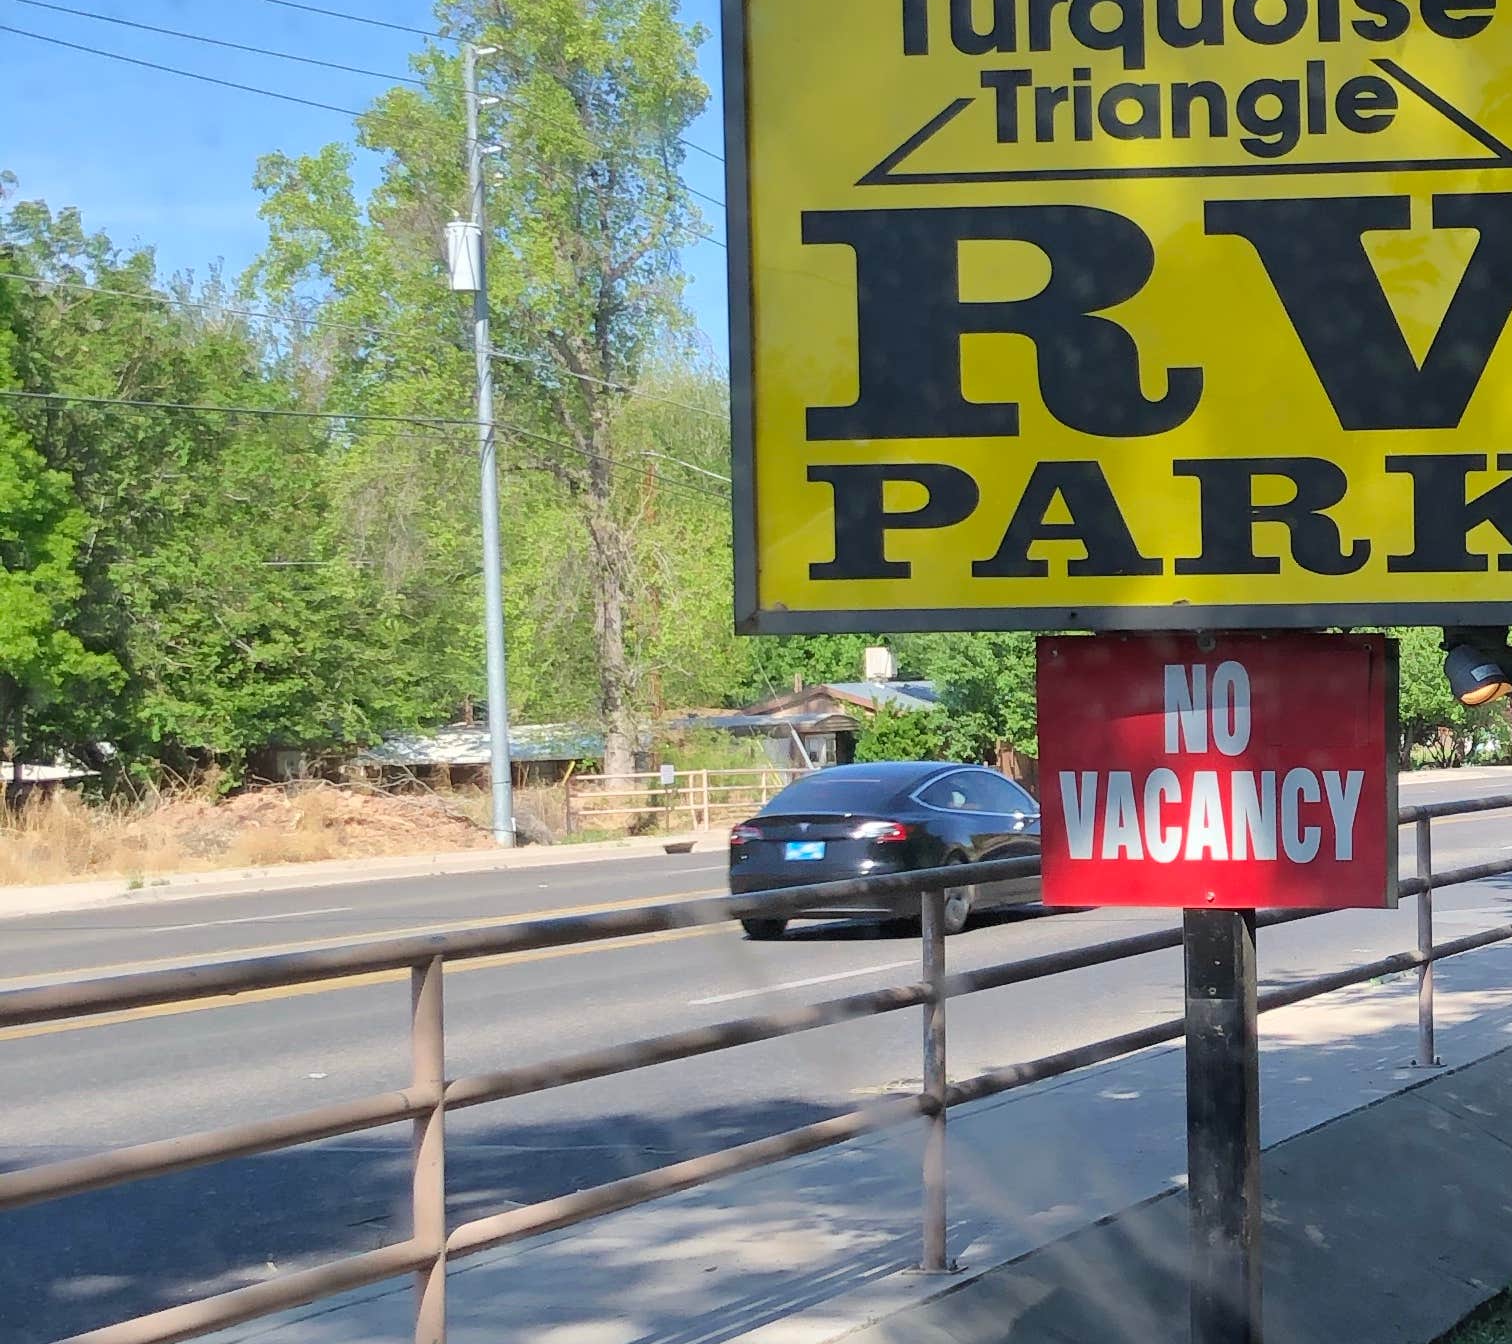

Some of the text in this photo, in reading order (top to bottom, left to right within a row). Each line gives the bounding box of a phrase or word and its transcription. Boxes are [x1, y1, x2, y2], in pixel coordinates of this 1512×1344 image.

[980, 59, 1400, 158] Triangle
[1163, 660, 1252, 756] NO
[1058, 767, 1365, 864] VACANCY
